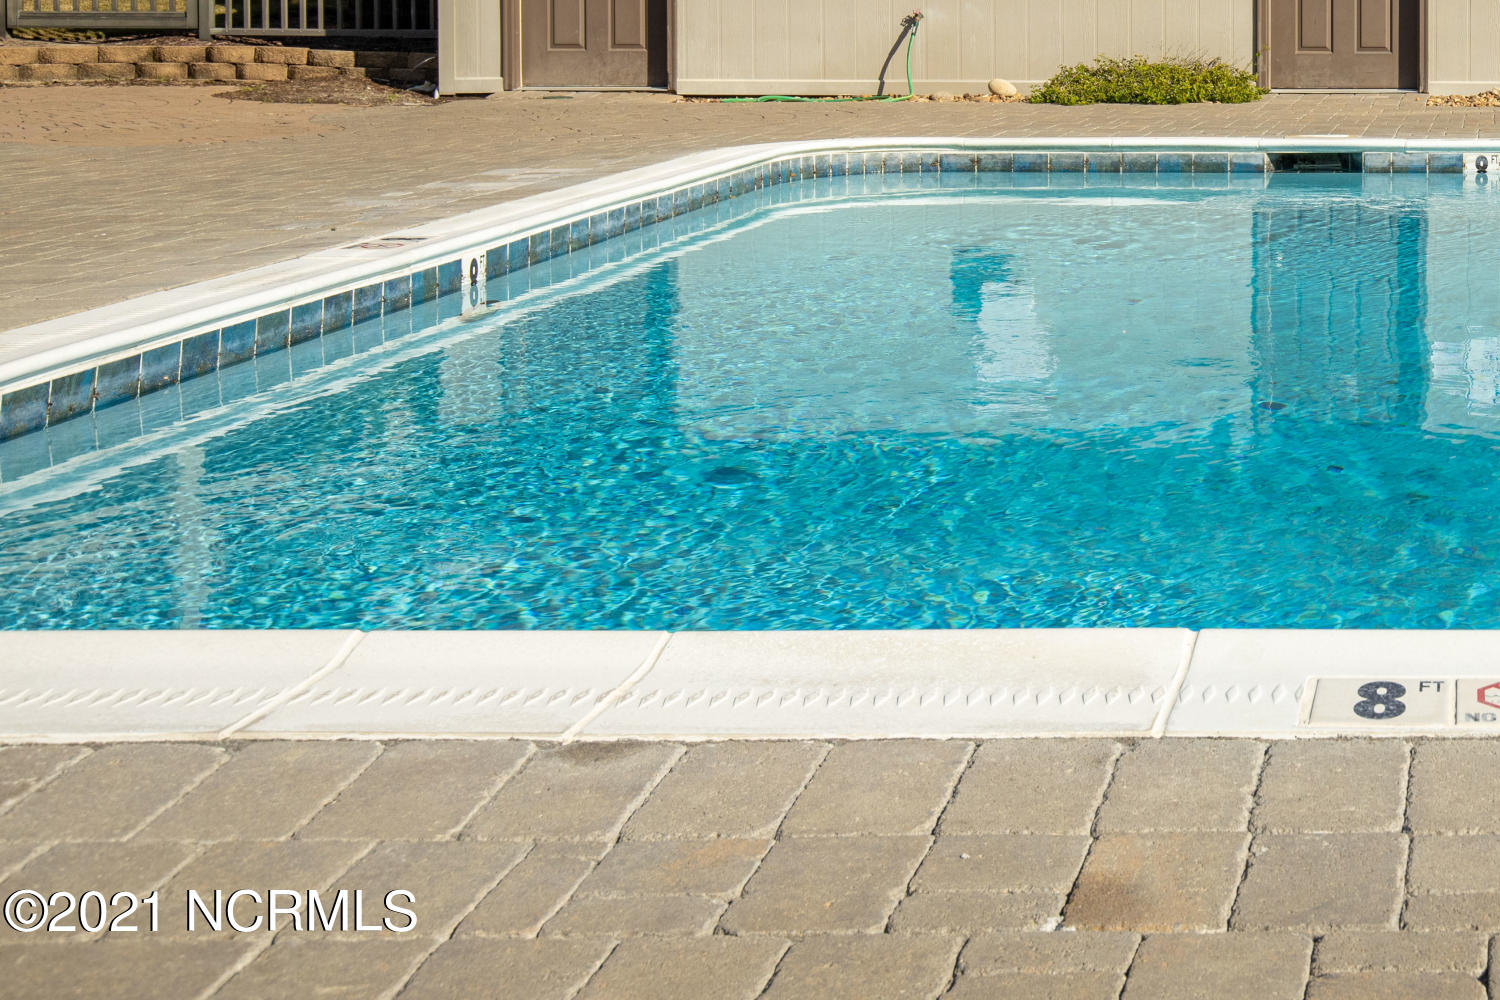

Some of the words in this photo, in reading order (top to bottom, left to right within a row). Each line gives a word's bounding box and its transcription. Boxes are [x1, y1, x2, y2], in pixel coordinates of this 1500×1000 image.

[1353, 681, 1406, 719] 8
[1419, 681, 1444, 692] FT
[1465, 712, 1497, 722] NO
